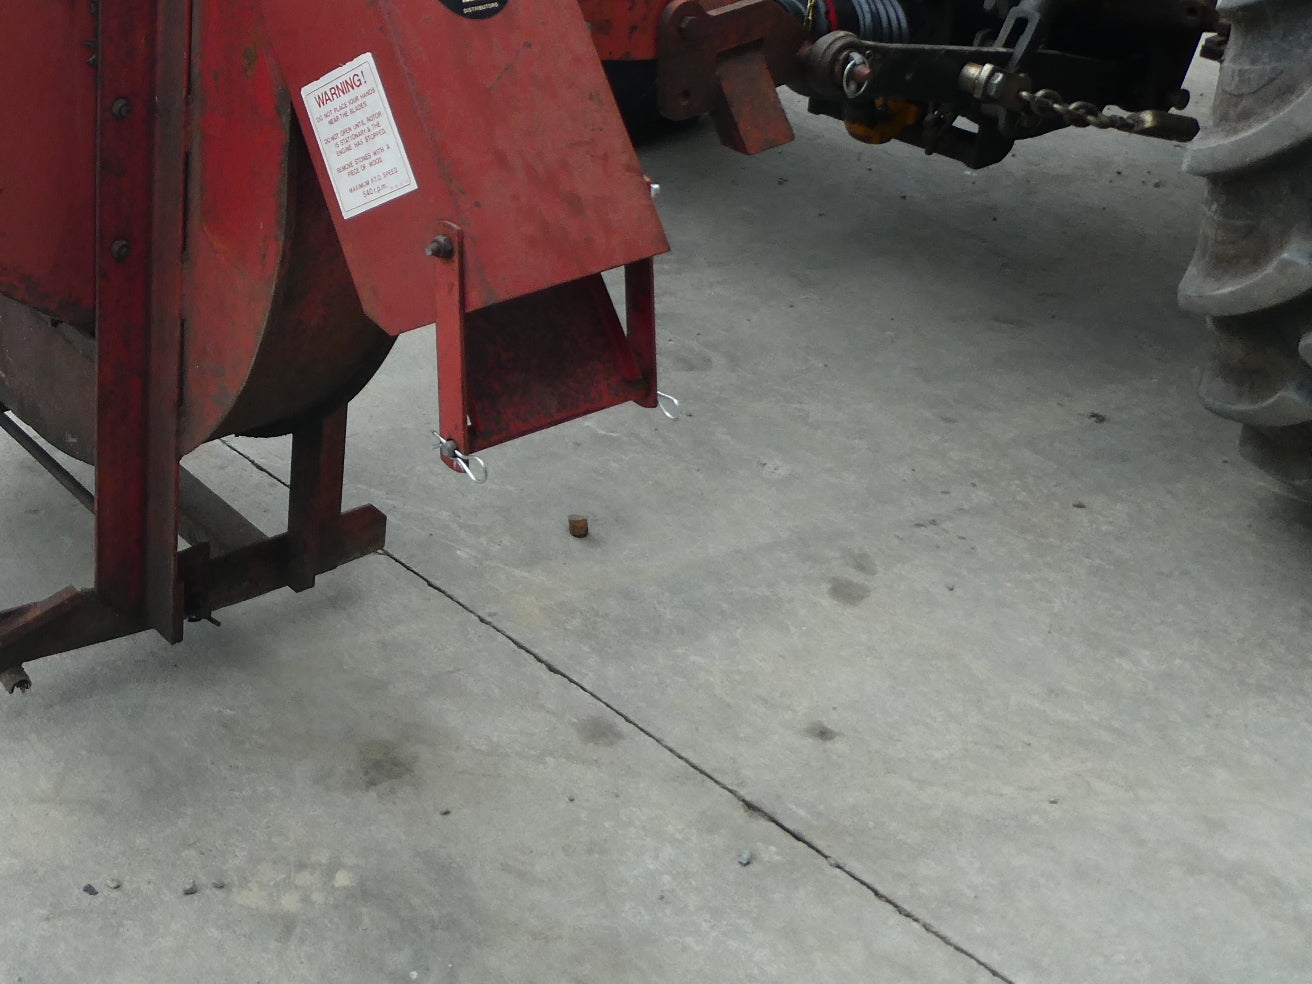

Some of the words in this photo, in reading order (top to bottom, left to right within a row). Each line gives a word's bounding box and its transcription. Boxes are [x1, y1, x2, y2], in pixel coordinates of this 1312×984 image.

[462, 2, 499, 14] DISTRIBUTORS
[333, 103, 349, 114] PLACE
[348, 95, 360, 106] YOUR
[360, 87, 376, 99] HANDS
[339, 111, 349, 120] THE
[349, 101, 368, 116] BLADES
[339, 127, 353, 137] OPEN
[365, 128, 386, 143] STOPPED
[336, 161, 354, 173] REMOVE
[373, 146, 385, 156] WITH
[348, 179, 370, 194] MAXIMUM
[382, 167, 399, 179] SPEED
